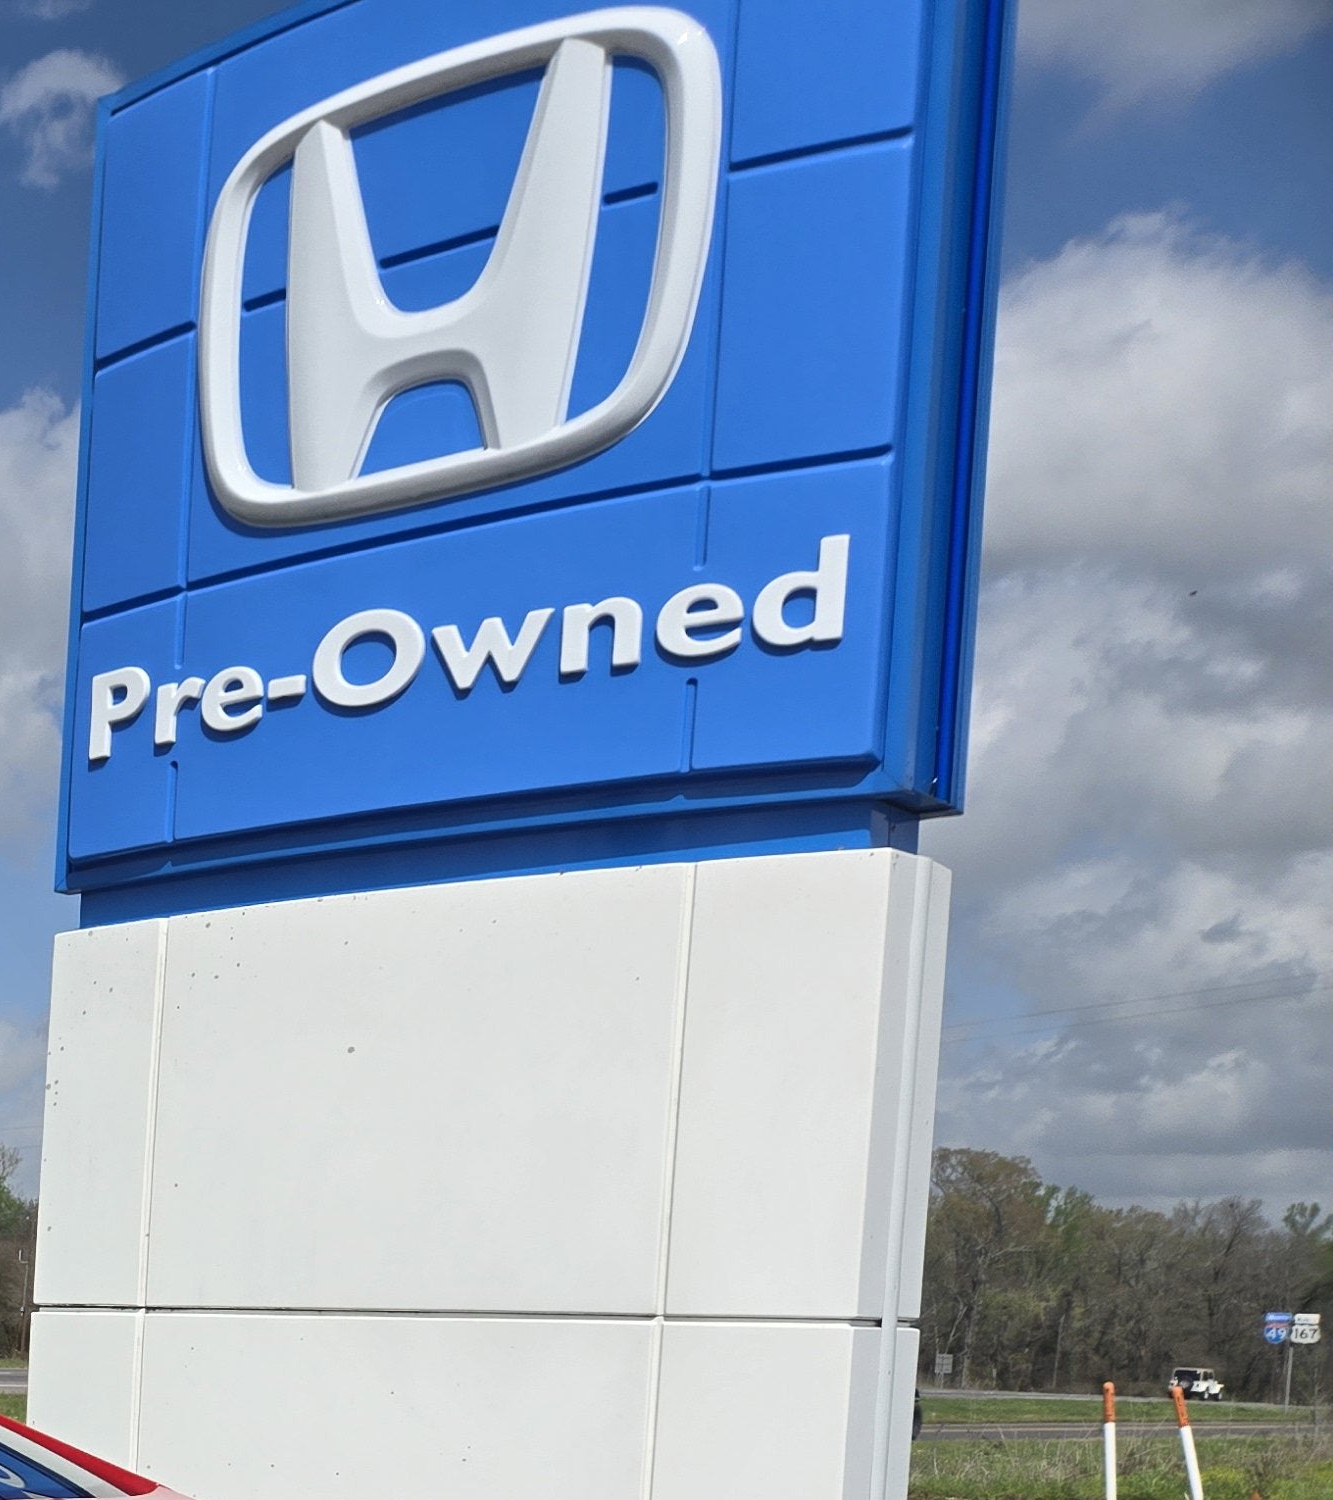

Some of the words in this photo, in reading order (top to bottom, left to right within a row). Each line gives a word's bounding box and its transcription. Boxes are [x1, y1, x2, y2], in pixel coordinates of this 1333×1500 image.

[88, 534, 850, 761] Pre-Owned
[1266, 1327, 1287, 1340] 49
[1294, 1328, 1318, 1339] 167
